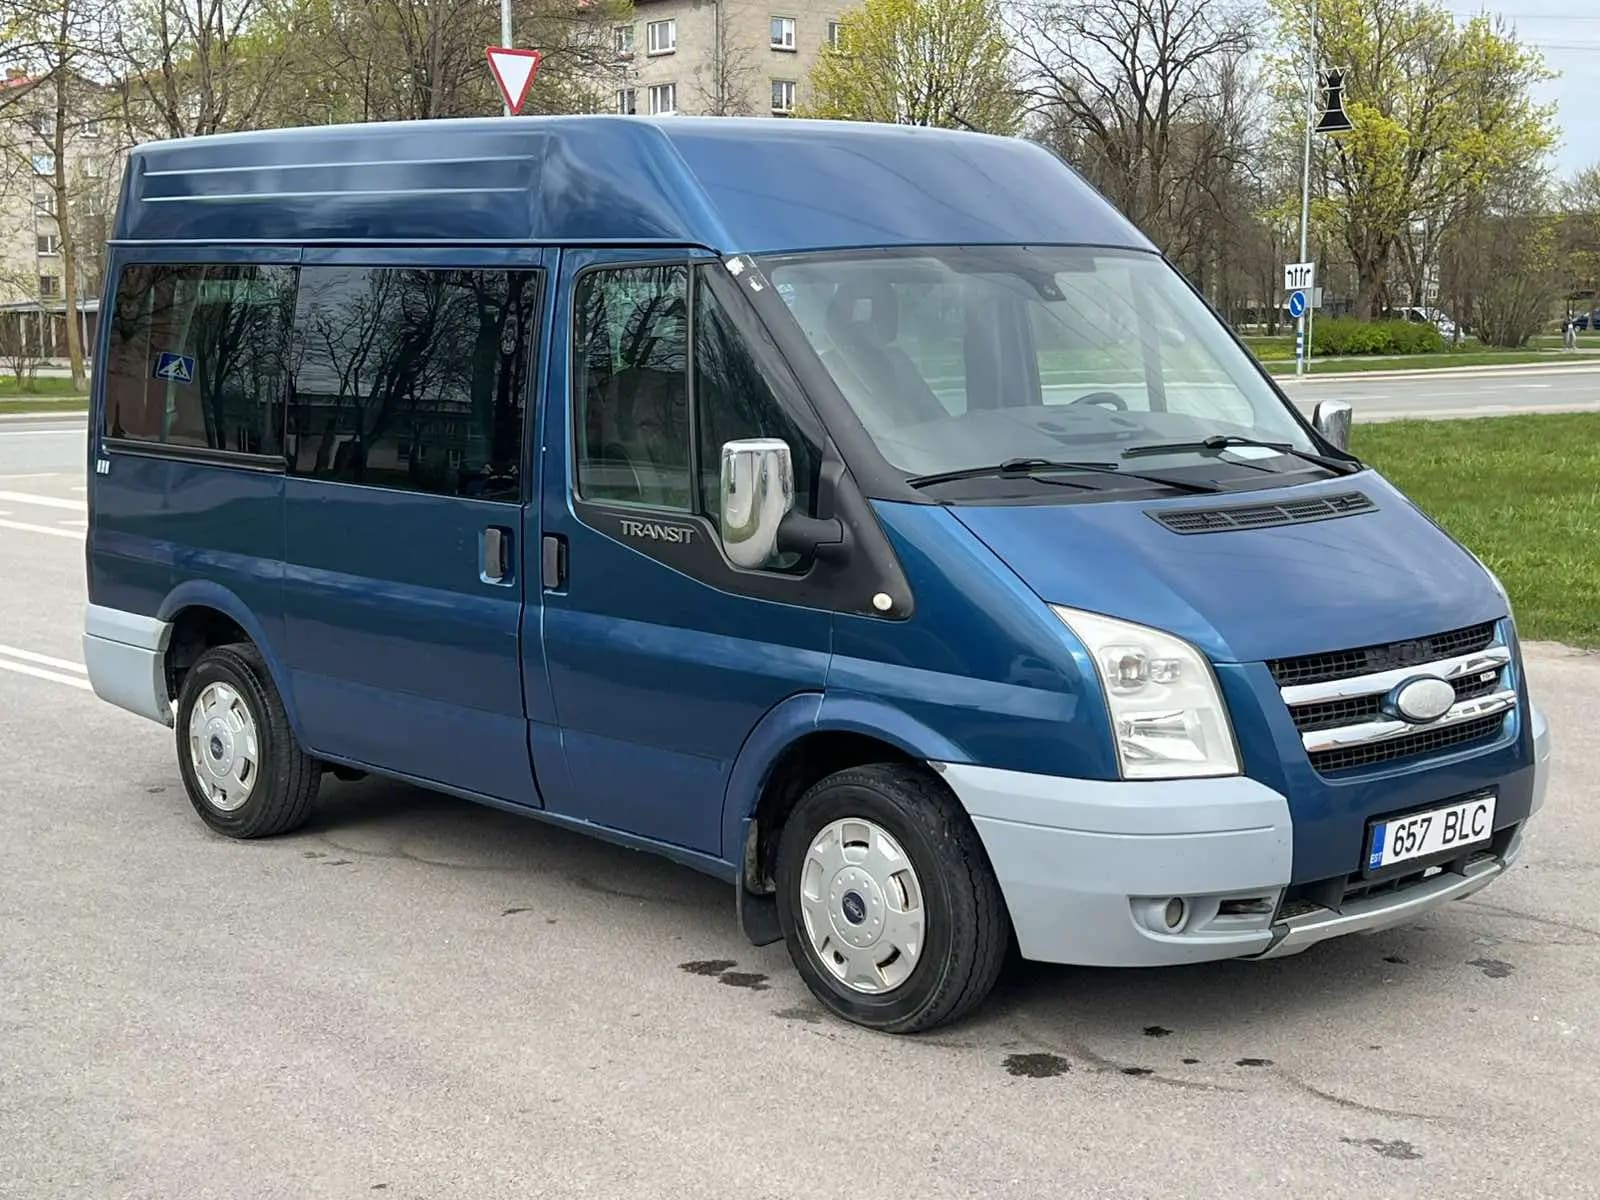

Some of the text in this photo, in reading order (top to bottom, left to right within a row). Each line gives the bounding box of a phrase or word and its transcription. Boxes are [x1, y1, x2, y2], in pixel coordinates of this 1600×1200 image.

[620, 520, 694, 544] TRANSIT
[1393, 804, 1487, 857] 657 BLC
[1370, 852, 1383, 864] EST
